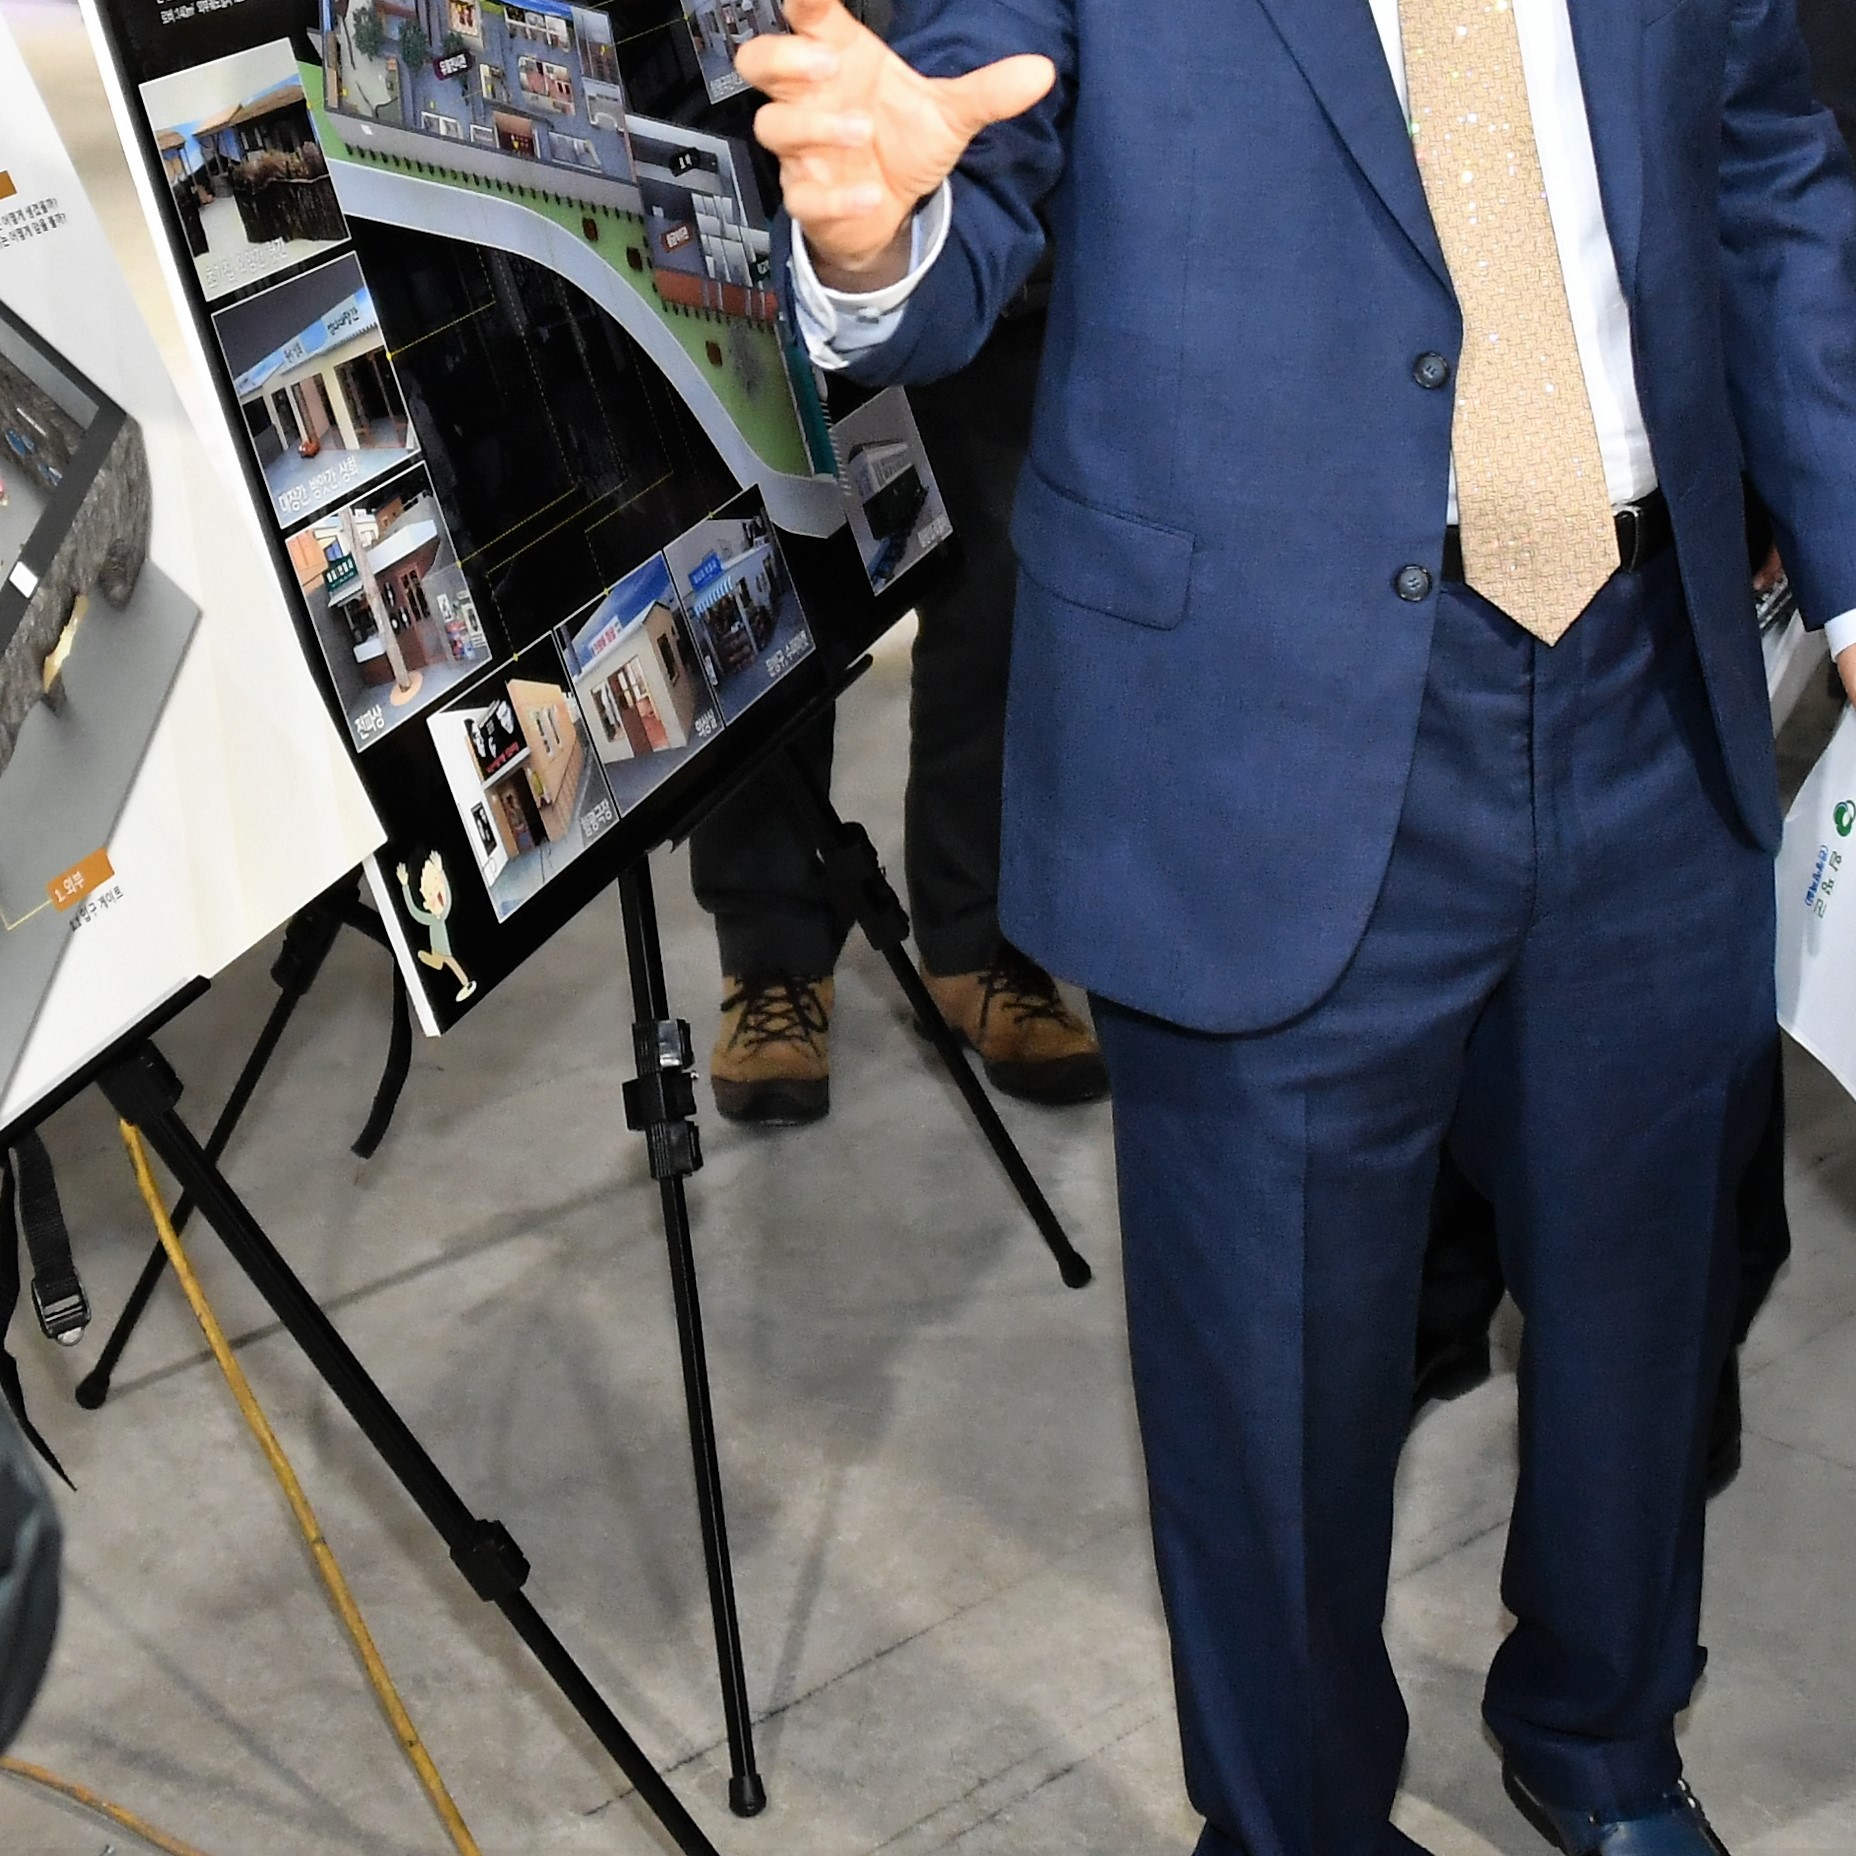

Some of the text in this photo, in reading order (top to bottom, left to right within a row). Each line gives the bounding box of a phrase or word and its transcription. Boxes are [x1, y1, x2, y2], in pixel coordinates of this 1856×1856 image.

[278, 488, 307, 513] 대장간
[308, 469, 338, 499] 방앗간
[354, 703, 385, 741] 전파상
[694, 708, 718, 738] 의상실
[580, 798, 613, 838] 함평극장
[63, 871, 84, 895] 외부
[80, 902, 97, 923] 입구
[98, 885, 124, 909] 게이트
